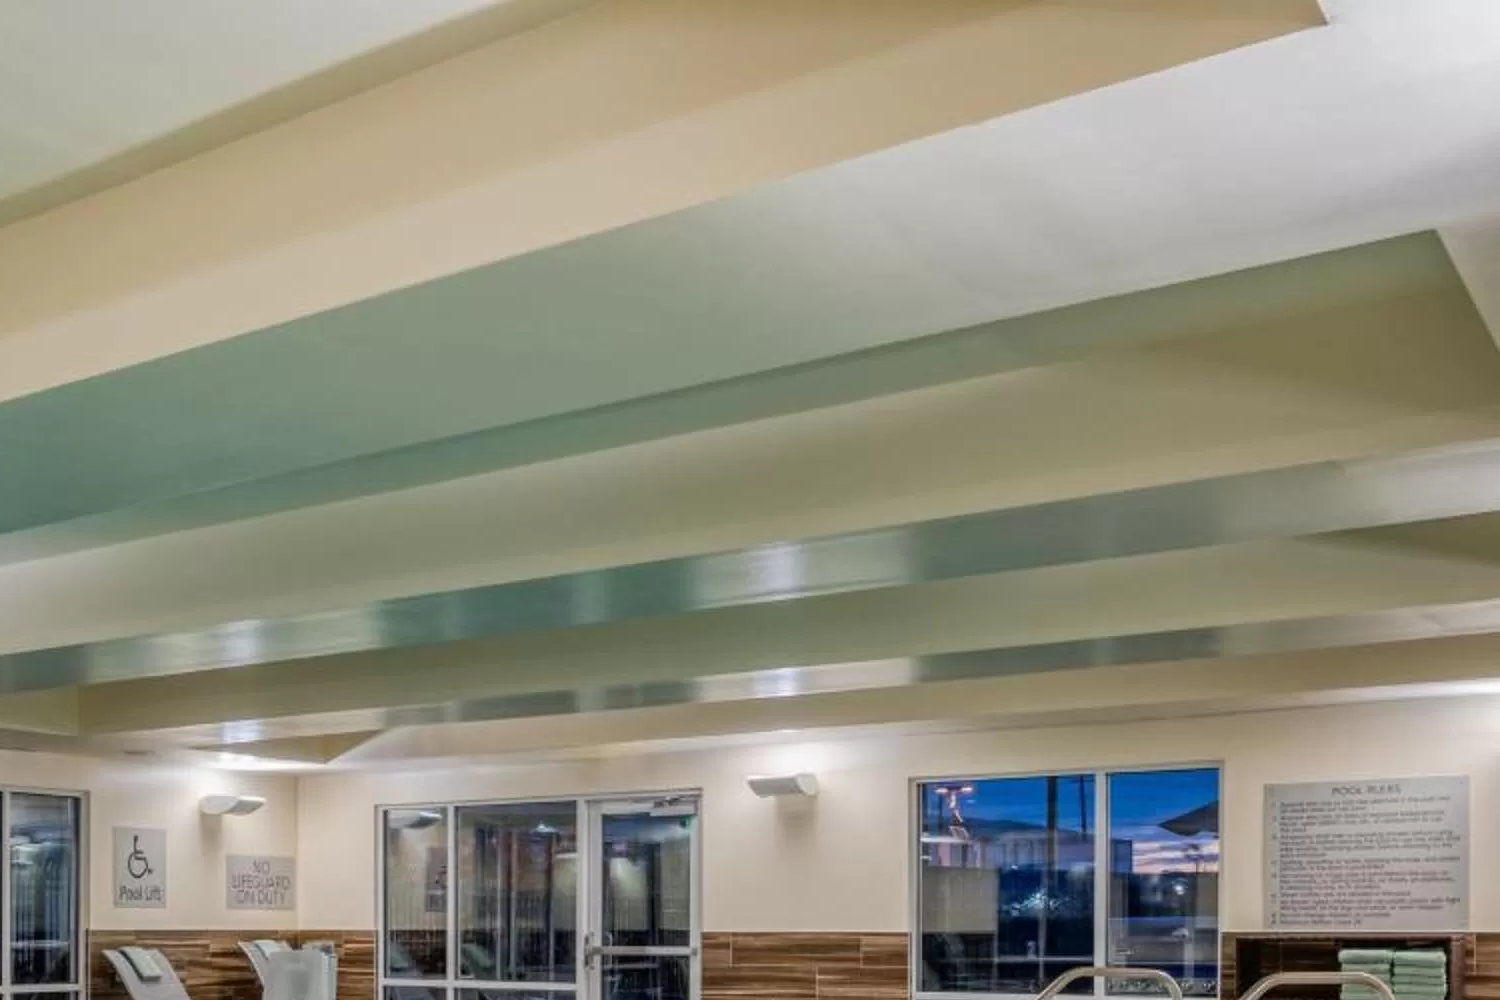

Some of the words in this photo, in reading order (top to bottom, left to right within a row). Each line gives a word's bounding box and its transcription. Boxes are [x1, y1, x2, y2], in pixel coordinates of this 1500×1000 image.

[253, 861, 271, 874] NO
[232, 875, 291, 889] LIFEGUARD
[119, 885, 142, 902] Pool
[146, 886, 162, 902] Lift
[237, 889, 254, 903] ON
[257, 890, 286, 905] DUTY
